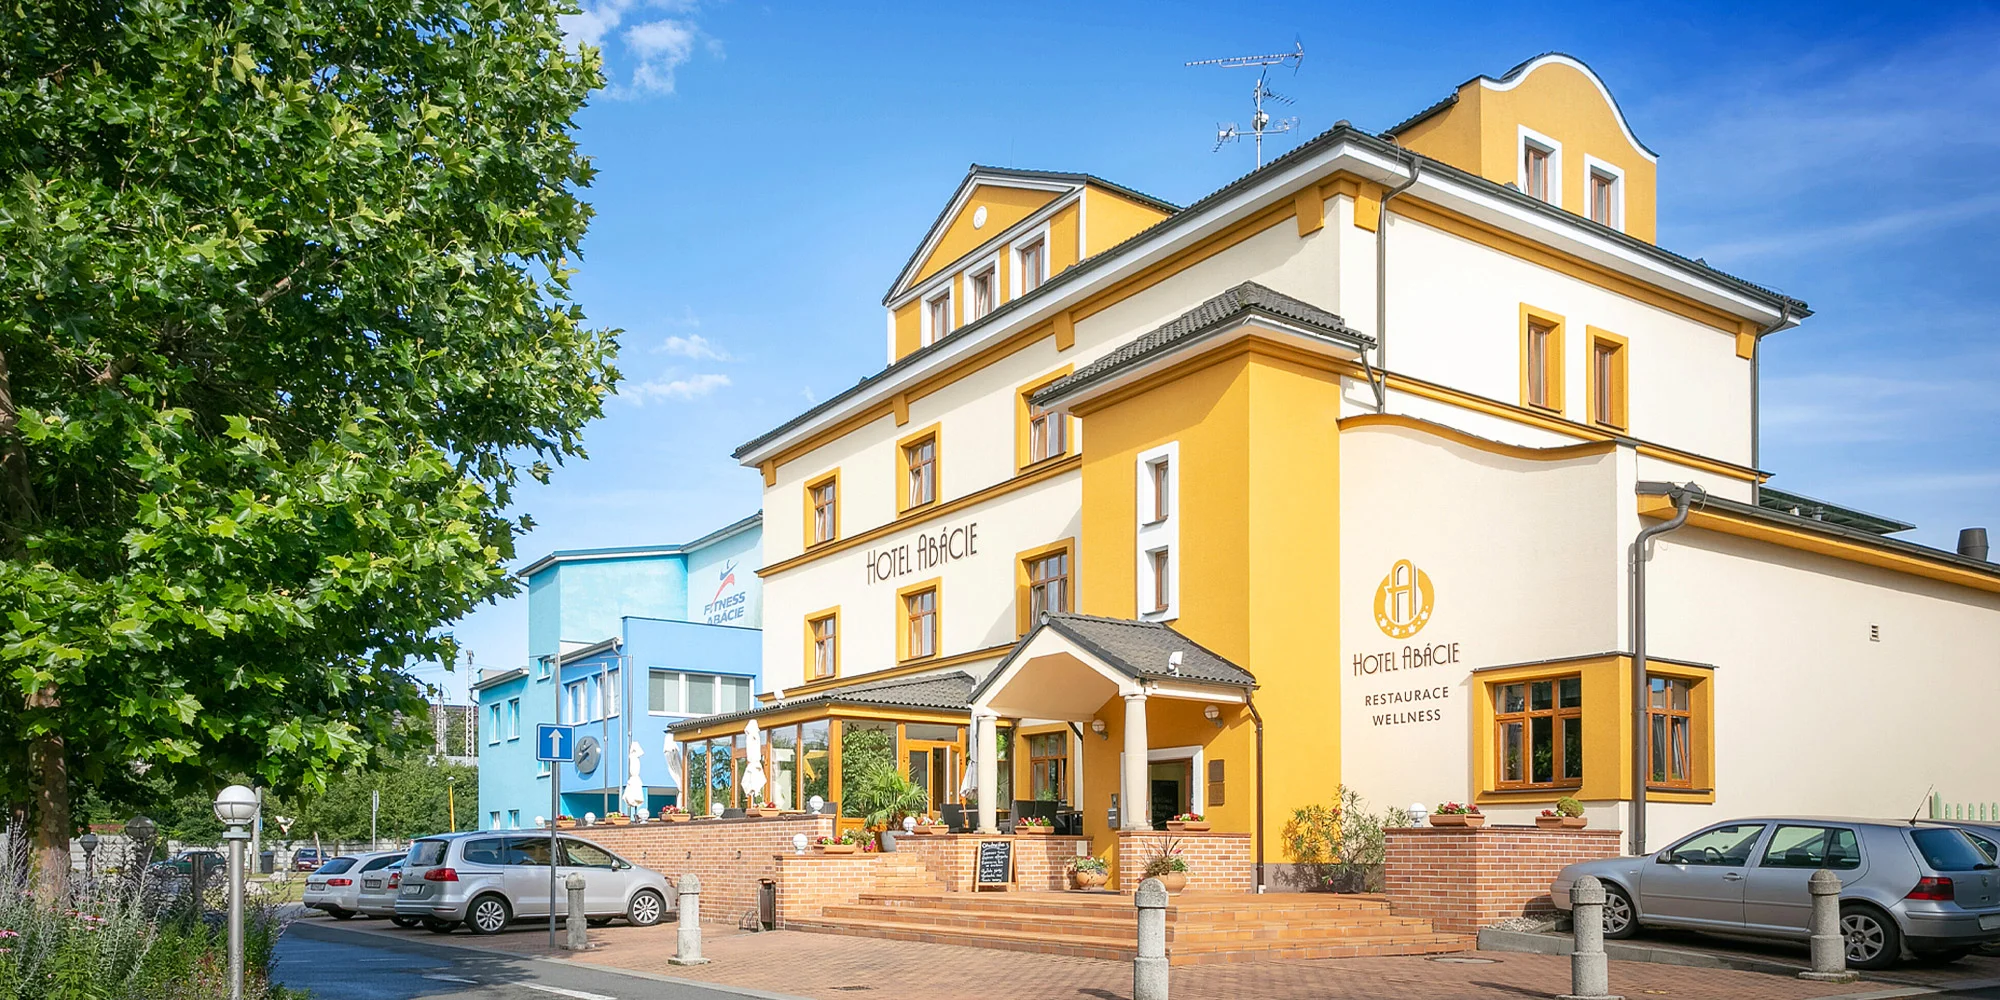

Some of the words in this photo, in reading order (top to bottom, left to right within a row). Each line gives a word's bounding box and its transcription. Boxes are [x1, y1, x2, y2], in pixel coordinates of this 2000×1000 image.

[866, 544, 912, 585] HOTEL
[917, 522, 977, 571] ABÁCIE
[704, 591, 746, 616] FITNESS
[1353, 652, 1398, 677] HOTEL
[1402, 642, 1460, 669] ABÁCIE
[1365, 687, 1449, 706] RESTAURACE
[1373, 709, 1441, 726] WELLNESS
